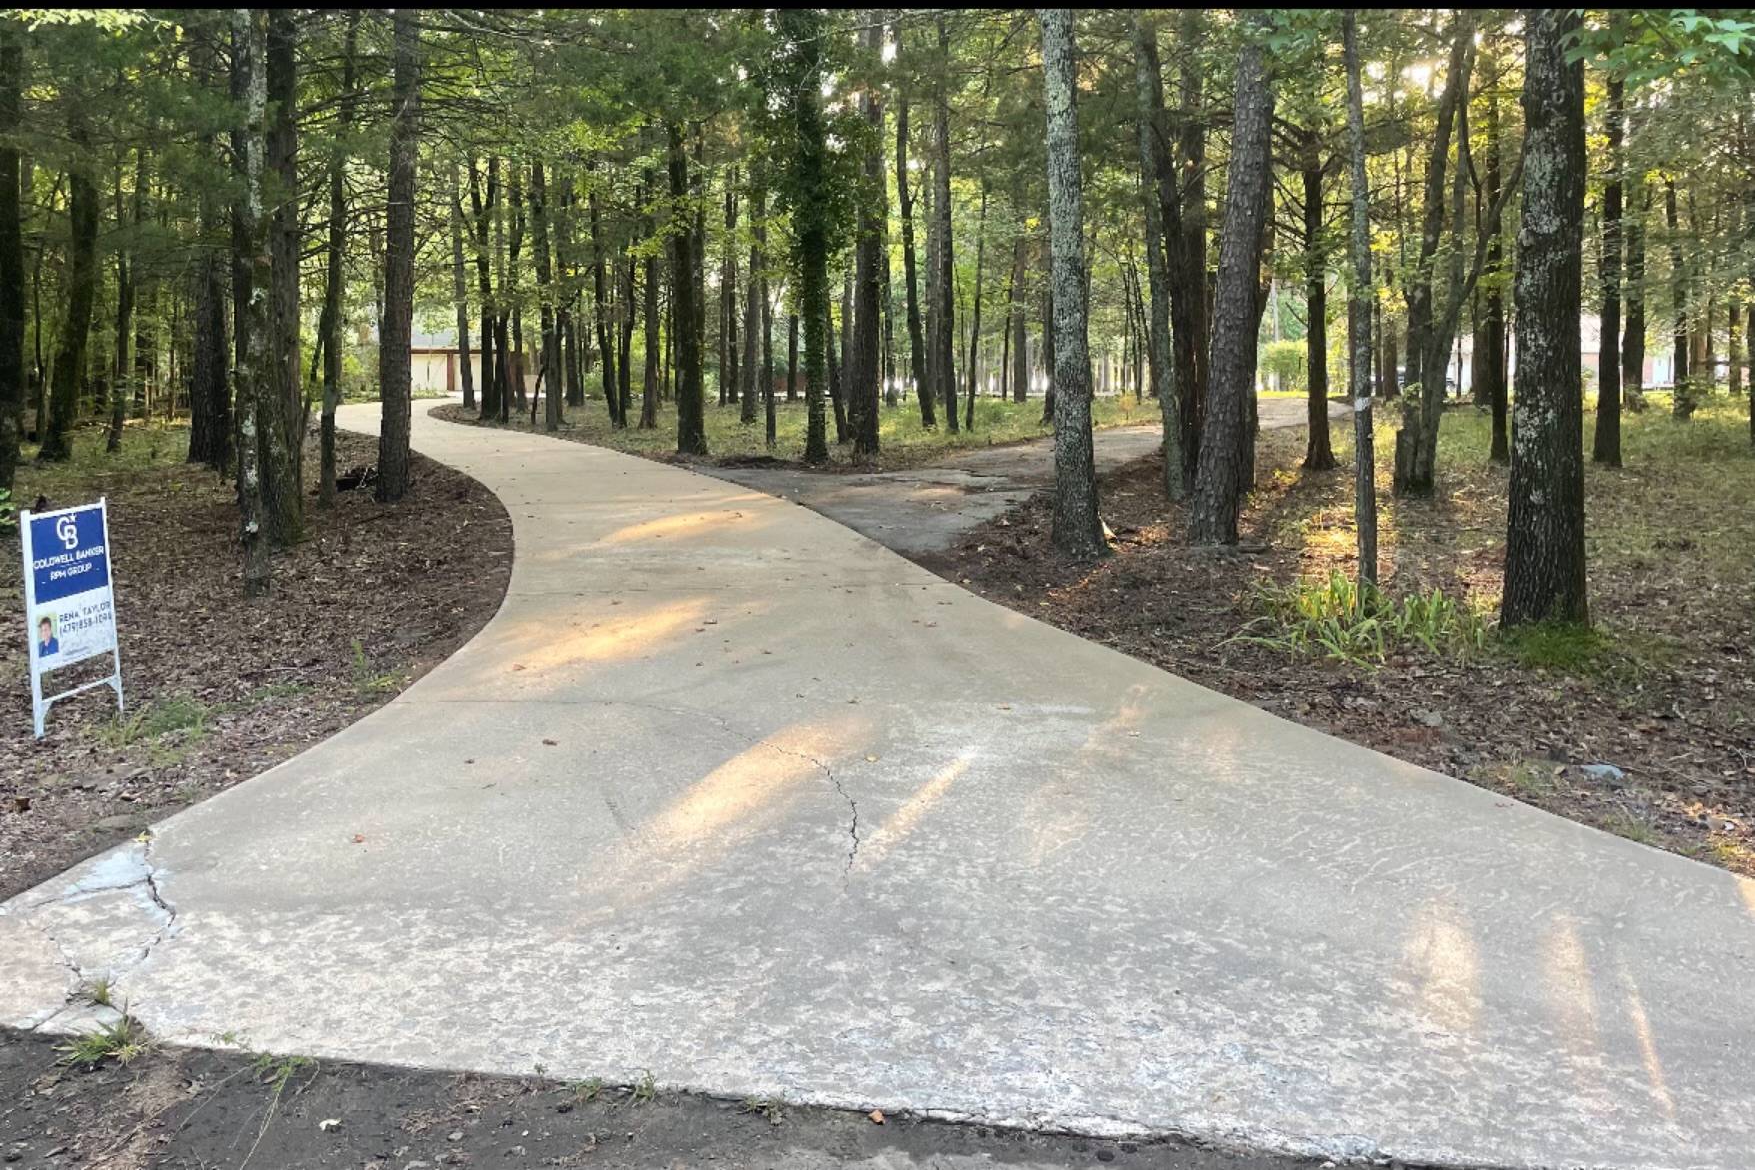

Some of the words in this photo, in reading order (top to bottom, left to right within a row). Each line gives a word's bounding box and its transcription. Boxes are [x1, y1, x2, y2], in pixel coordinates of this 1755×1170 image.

[33, 553, 74, 570] COLDWELL
[76, 545, 105, 560] BANKER
[50, 570, 67, 581] RPM
[67, 562, 92, 577] GROUP
[59, 610, 80, 623] RENA
[83, 600, 111, 616] TAYLOR
